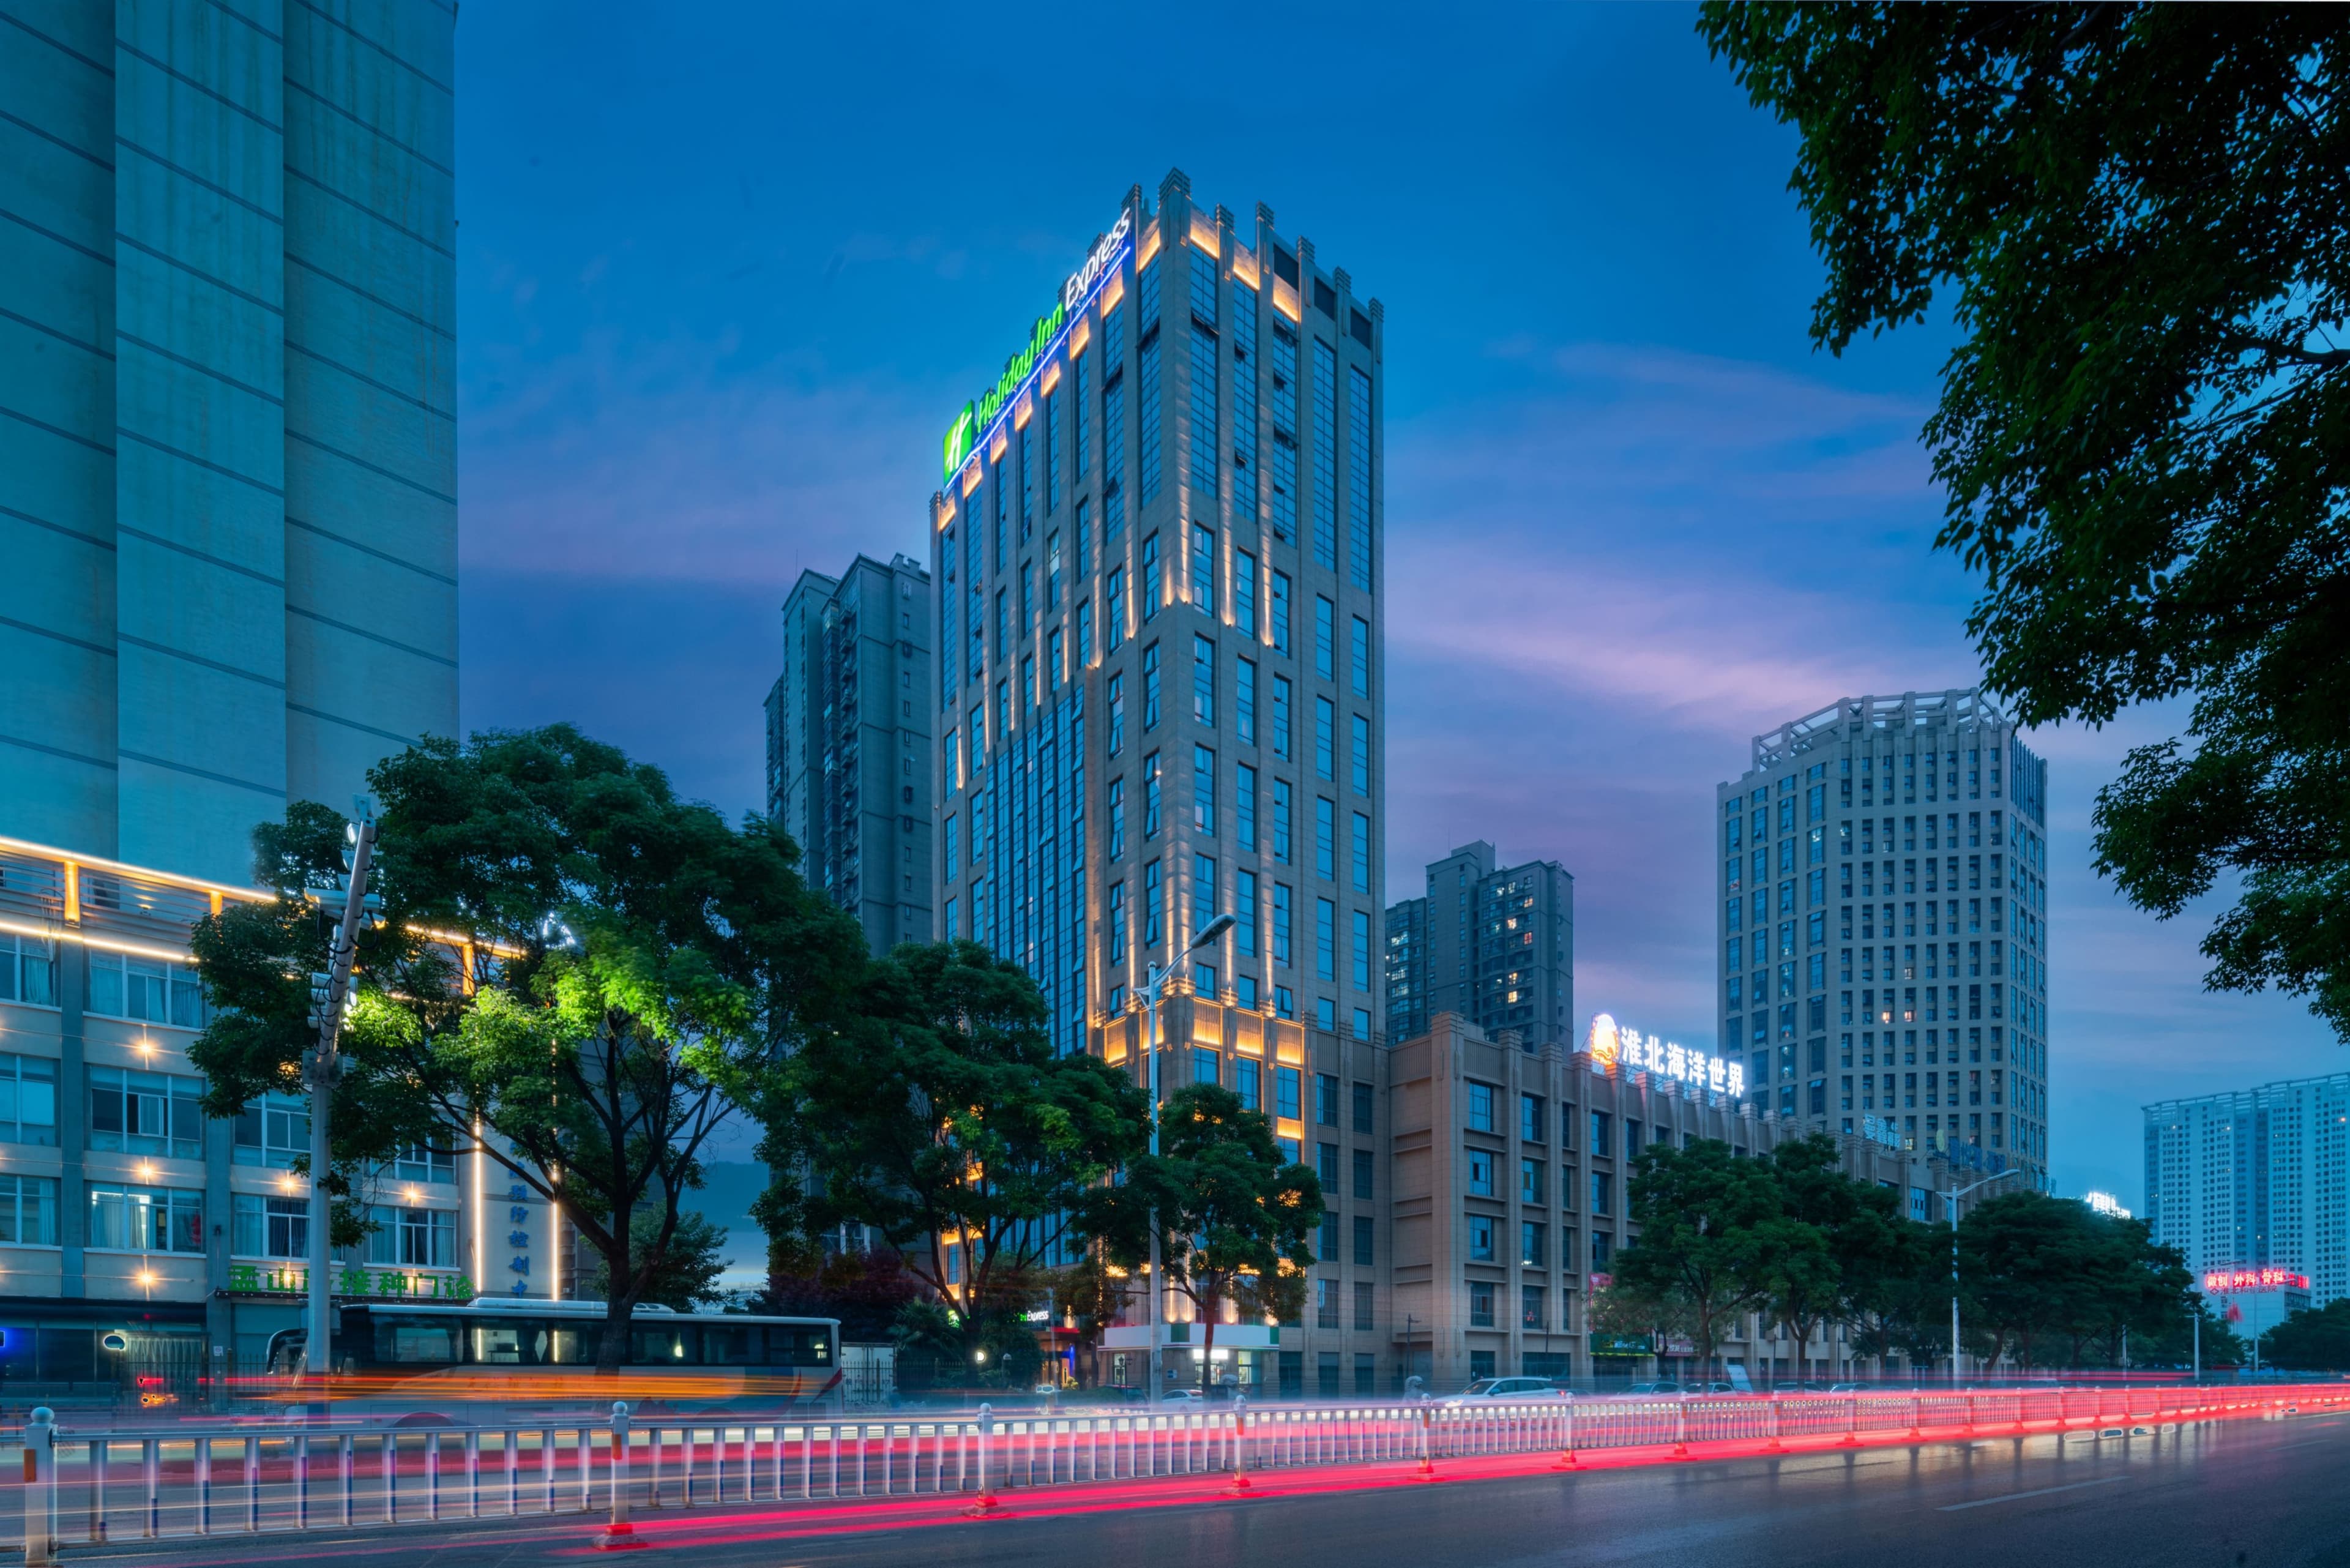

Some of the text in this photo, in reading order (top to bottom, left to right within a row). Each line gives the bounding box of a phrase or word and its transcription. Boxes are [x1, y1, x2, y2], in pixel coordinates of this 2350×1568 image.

[977, 207, 1130, 433] Holiday Inn Express
[1621, 1026, 1745, 1097] 淮北海洋世界
[228, 1264, 476, 1299] 孟山接种门诊
